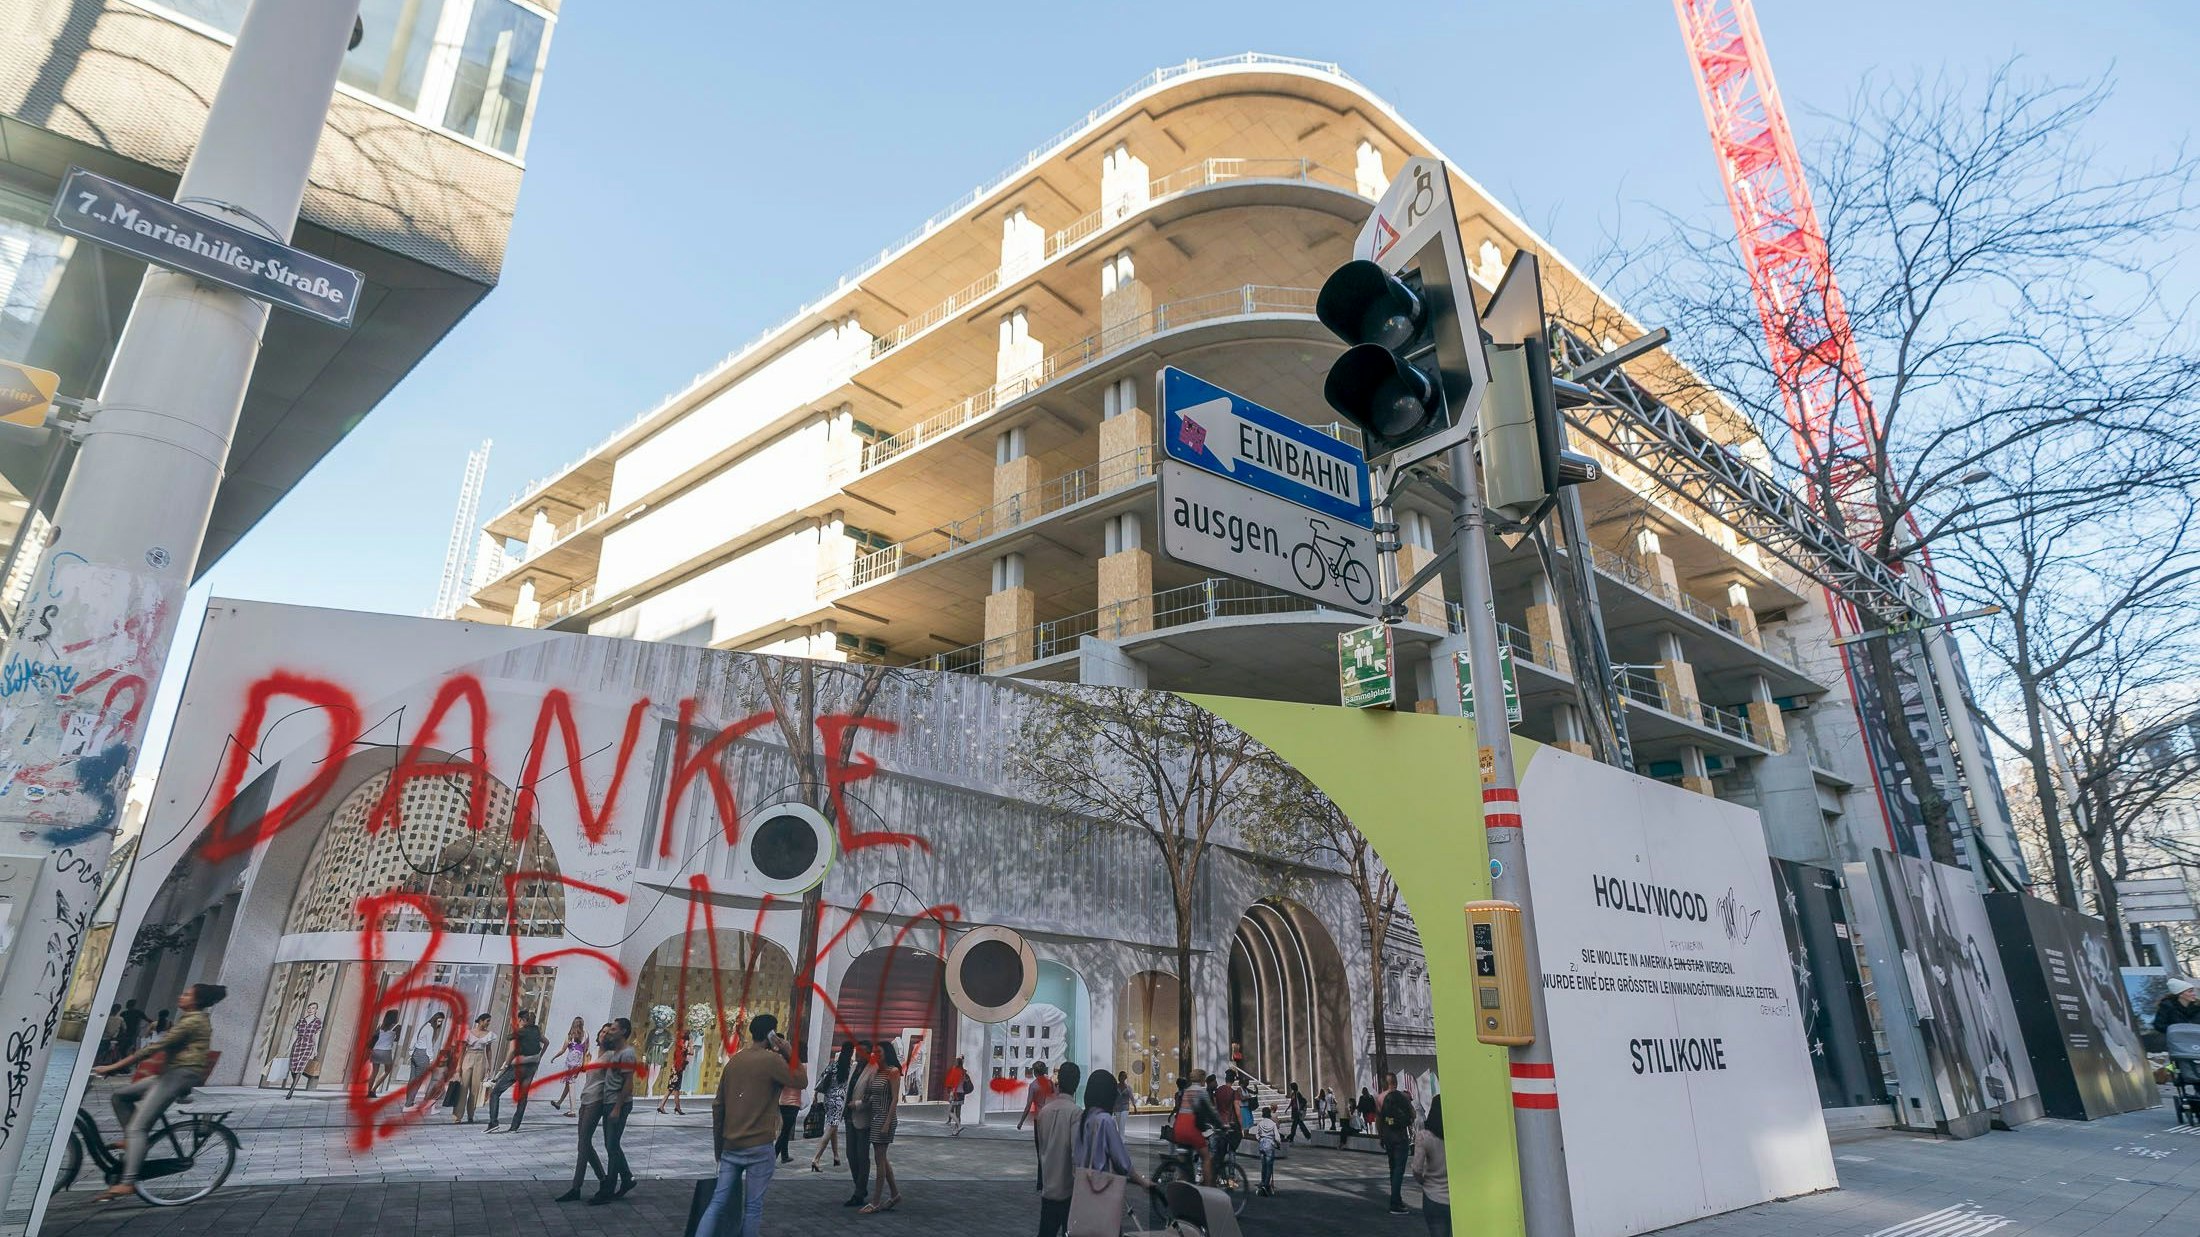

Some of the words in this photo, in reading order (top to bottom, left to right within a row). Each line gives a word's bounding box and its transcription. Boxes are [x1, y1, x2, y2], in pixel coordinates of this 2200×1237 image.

[108, 202, 266, 277] Mariahilfer
[264, 258, 344, 304] Straße
[1239, 422, 1350, 498] EINBAHN
[1587, 465, 1595, 478] 3
[1173, 497, 1288, 559] ausgen.
[1345, 687, 1391, 704] Sammelplatz
[200, 668, 931, 864] DANKE
[1593, 874, 1708, 923] HOLLYWOOD
[1582, 949, 1596, 963] SIE
[1597, 950, 1629, 966] WOLLTE
[1629, 953, 1638, 967] IN
[1640, 954, 1674, 970] AMERIKA
[1673, 957, 1687, 971] EIN
[1687, 958, 1704, 972] STAR
[1705, 961, 1735, 975] WERDEN.
[1598, 977, 1616, 992] DER
[1617, 976, 1659, 994] GRÖSSTEN
[1659, 981, 1735, 998] LEINWANDGÖTTINNEN
[1735, 986, 1755, 998] ALLER
[1755, 987, 1779, 999] ZEITEN.
[1630, 1038, 1727, 1074] STILIKONE
